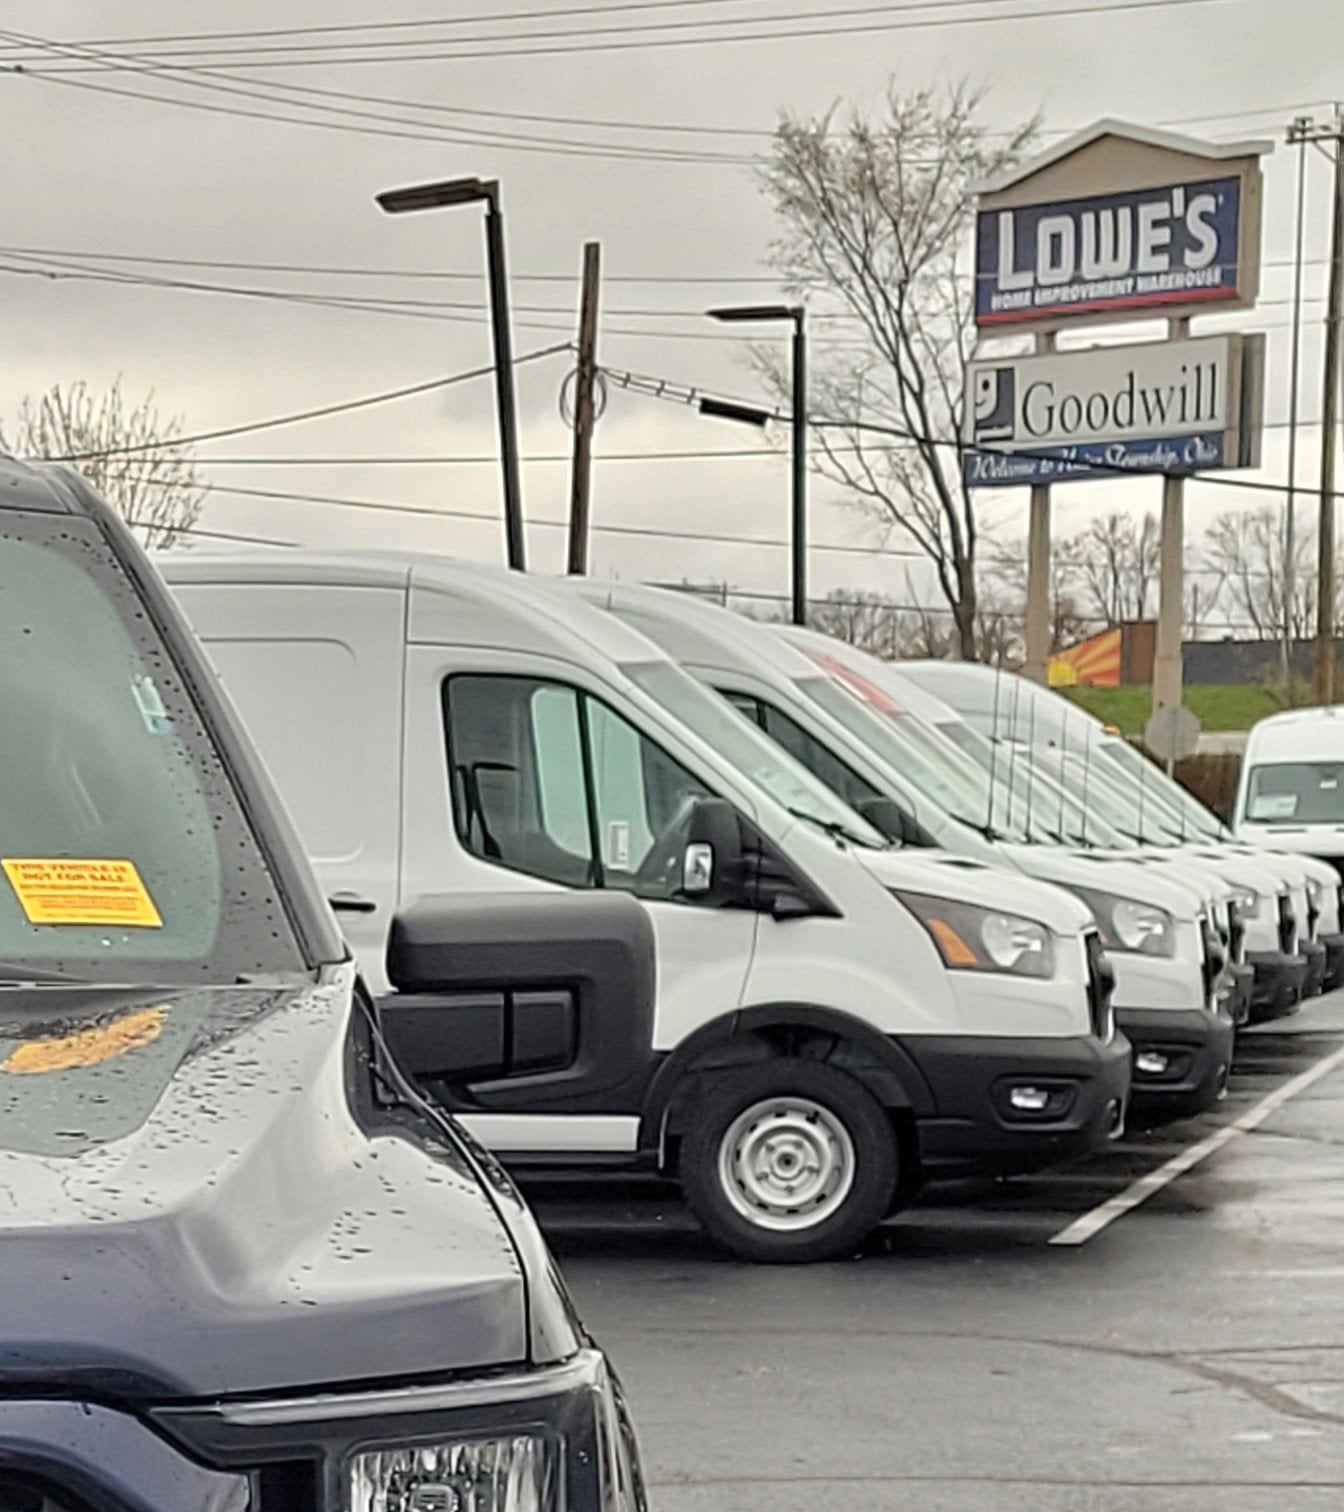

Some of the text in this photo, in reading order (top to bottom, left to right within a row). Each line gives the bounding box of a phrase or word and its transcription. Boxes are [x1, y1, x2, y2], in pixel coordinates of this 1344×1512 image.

[997, 187, 1220, 291] LOWE'S
[991, 266, 1222, 311] HOME IMPROVEMENT WAREHOUSE
[1021, 362, 1219, 438] Goodwill
[22, 872, 51, 881] NOT
[89, 873, 124, 883] SALE
